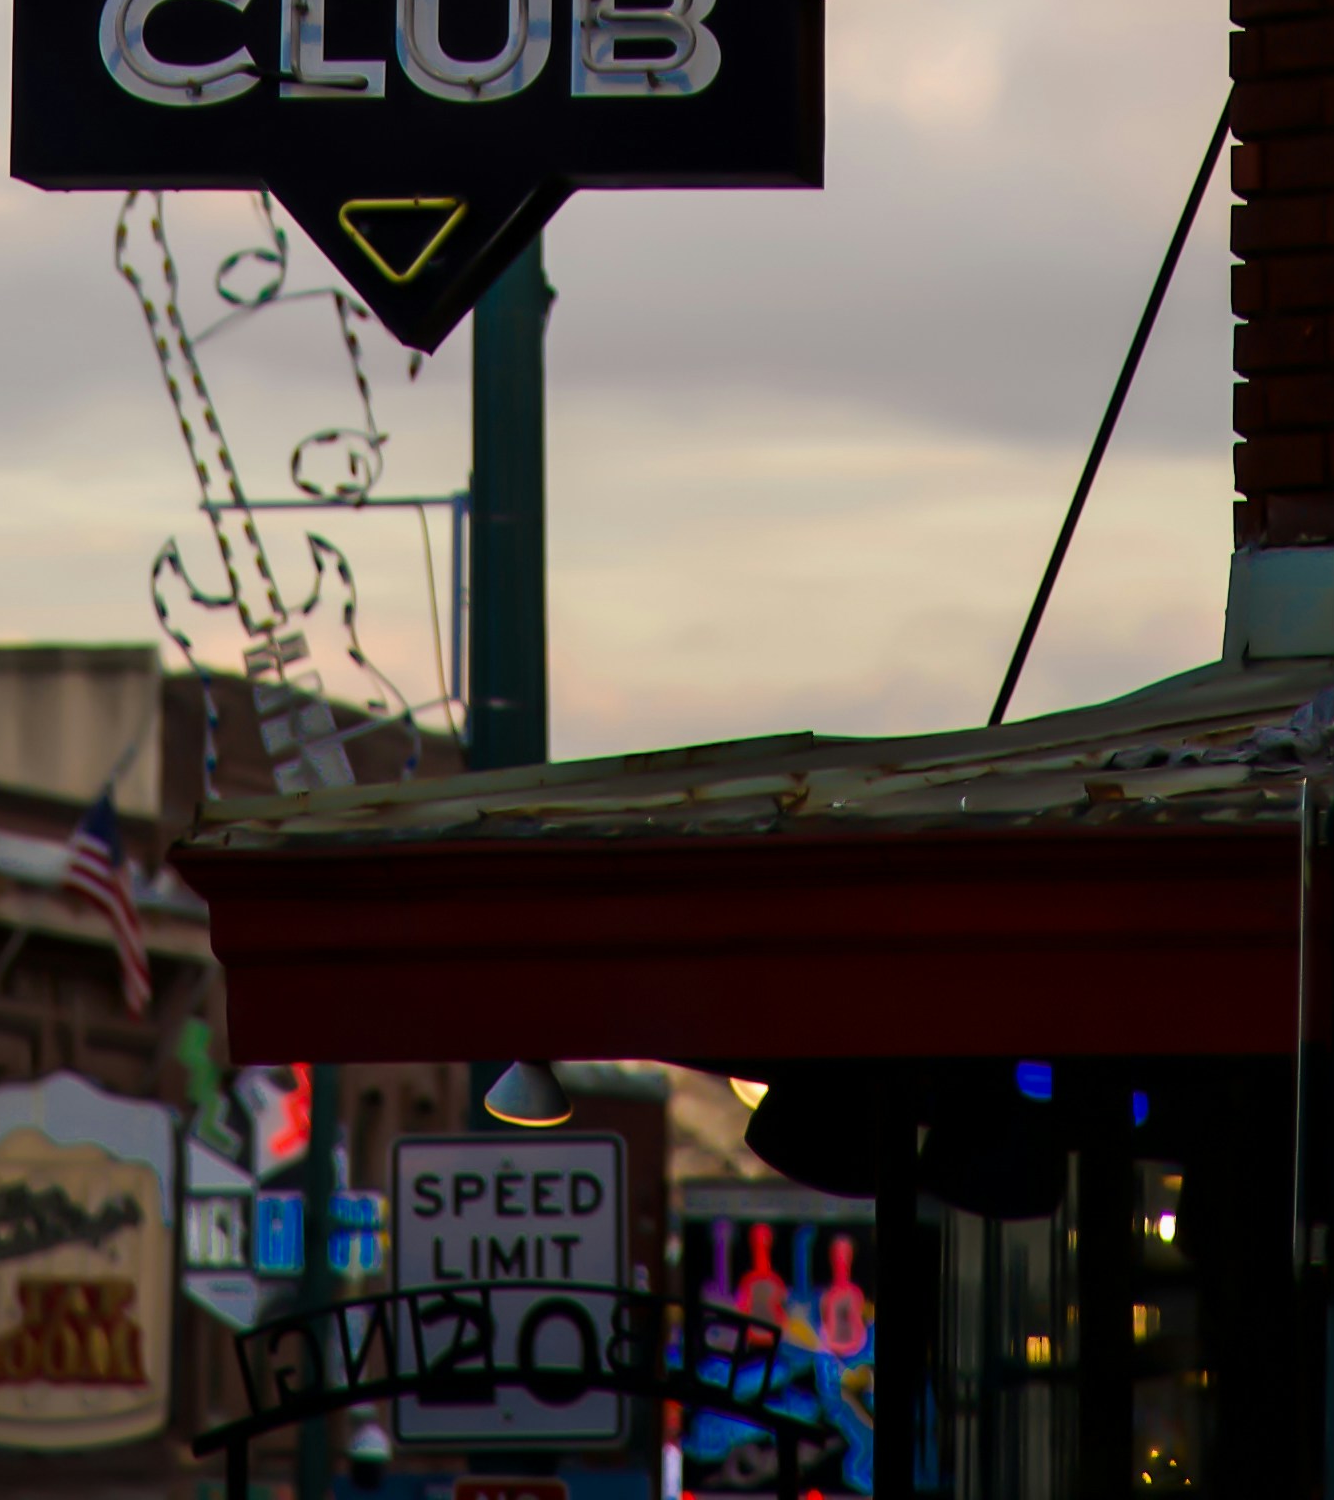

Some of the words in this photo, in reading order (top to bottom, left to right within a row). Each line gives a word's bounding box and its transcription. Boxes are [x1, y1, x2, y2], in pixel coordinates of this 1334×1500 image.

[411, 1172, 605, 1218] SPEED
[433, 1235, 582, 1281] LIMIT
[417, 1297, 599, 1406] 20
